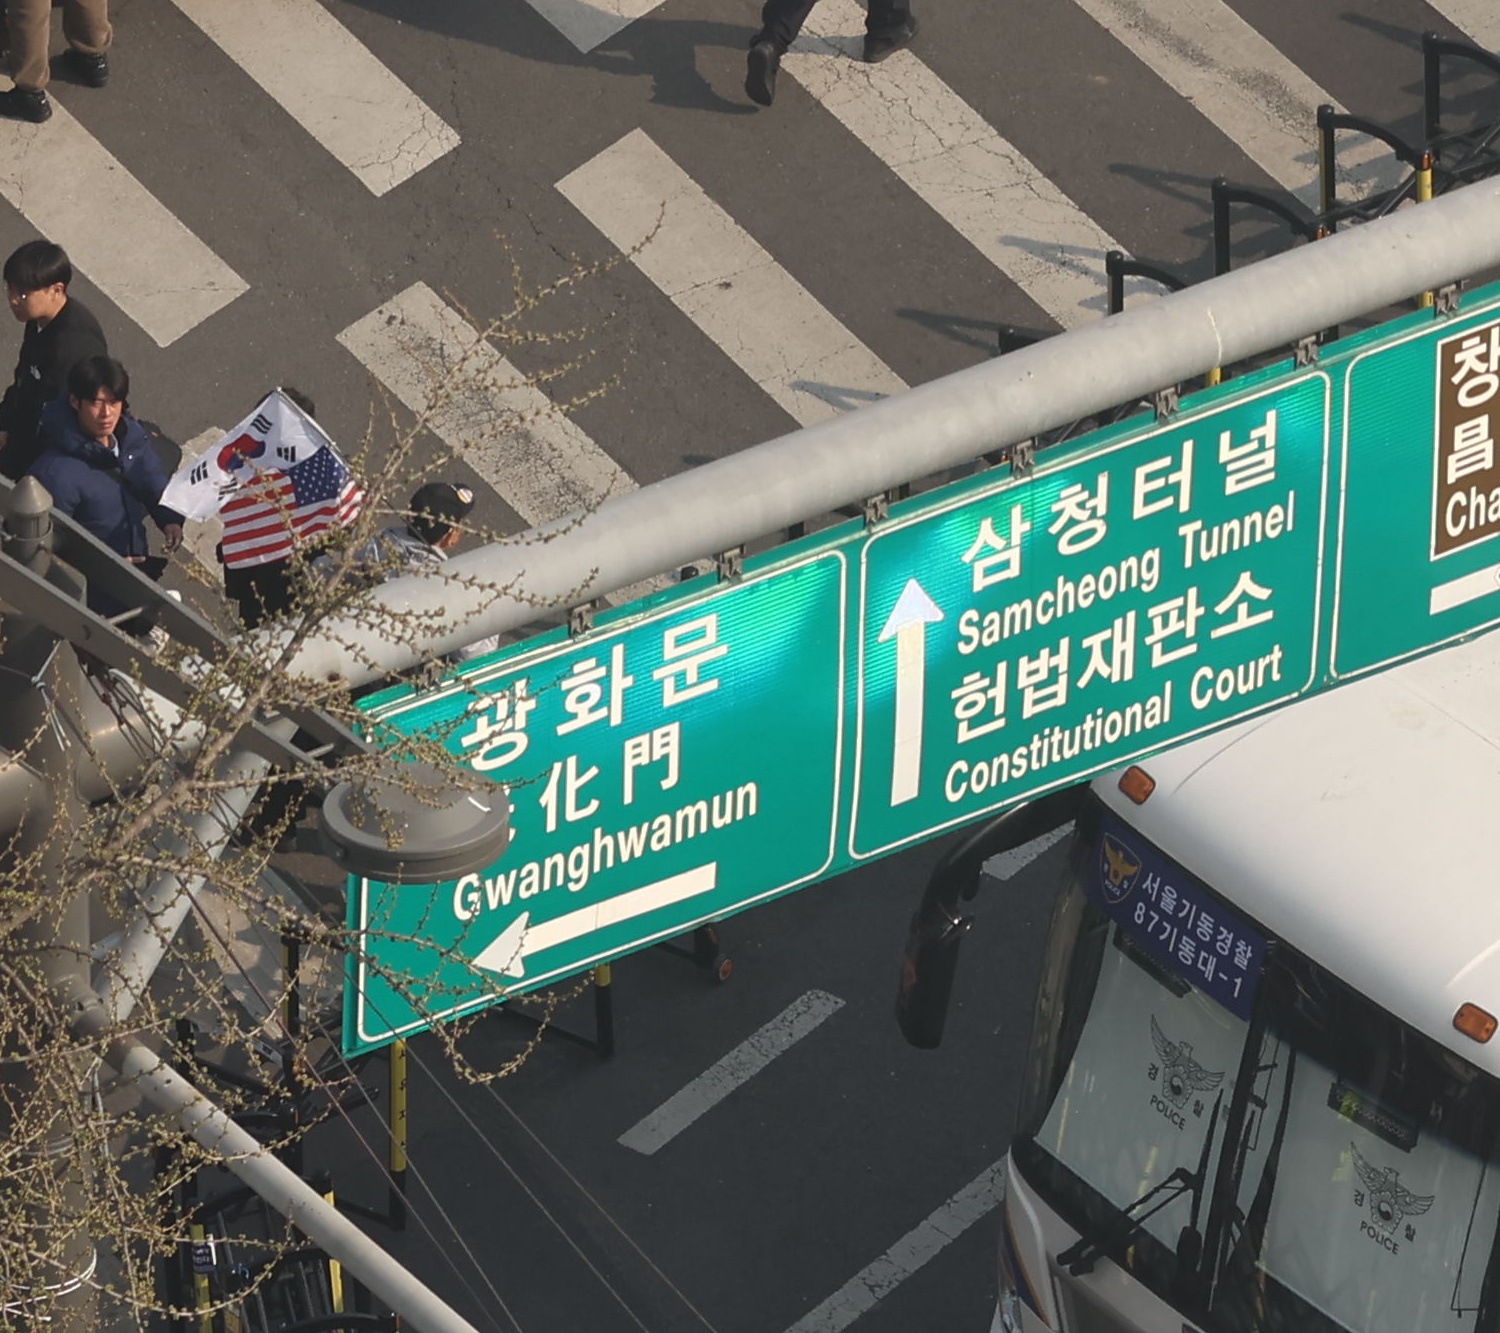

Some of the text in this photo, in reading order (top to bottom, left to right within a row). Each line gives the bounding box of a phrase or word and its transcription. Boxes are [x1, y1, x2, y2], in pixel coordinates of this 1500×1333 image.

[956, 490, 1296, 656] Samcheong Tunnel
[960, 407, 1280, 593] 삼청터널
[458, 613, 729, 772] 광화문
[944, 642, 1284, 806] Constitutional Court
[951, 570, 1275, 744] 헌법재판소
[451, 780, 759, 922] Gwanghwamun
[1141, 871, 1253, 971] 서울기동경찰
[1133, 901, 1242, 998] 87기동대-1
[1149, 1094, 1187, 1132] POLICE
[1359, 1220, 1400, 1256] POLICE
